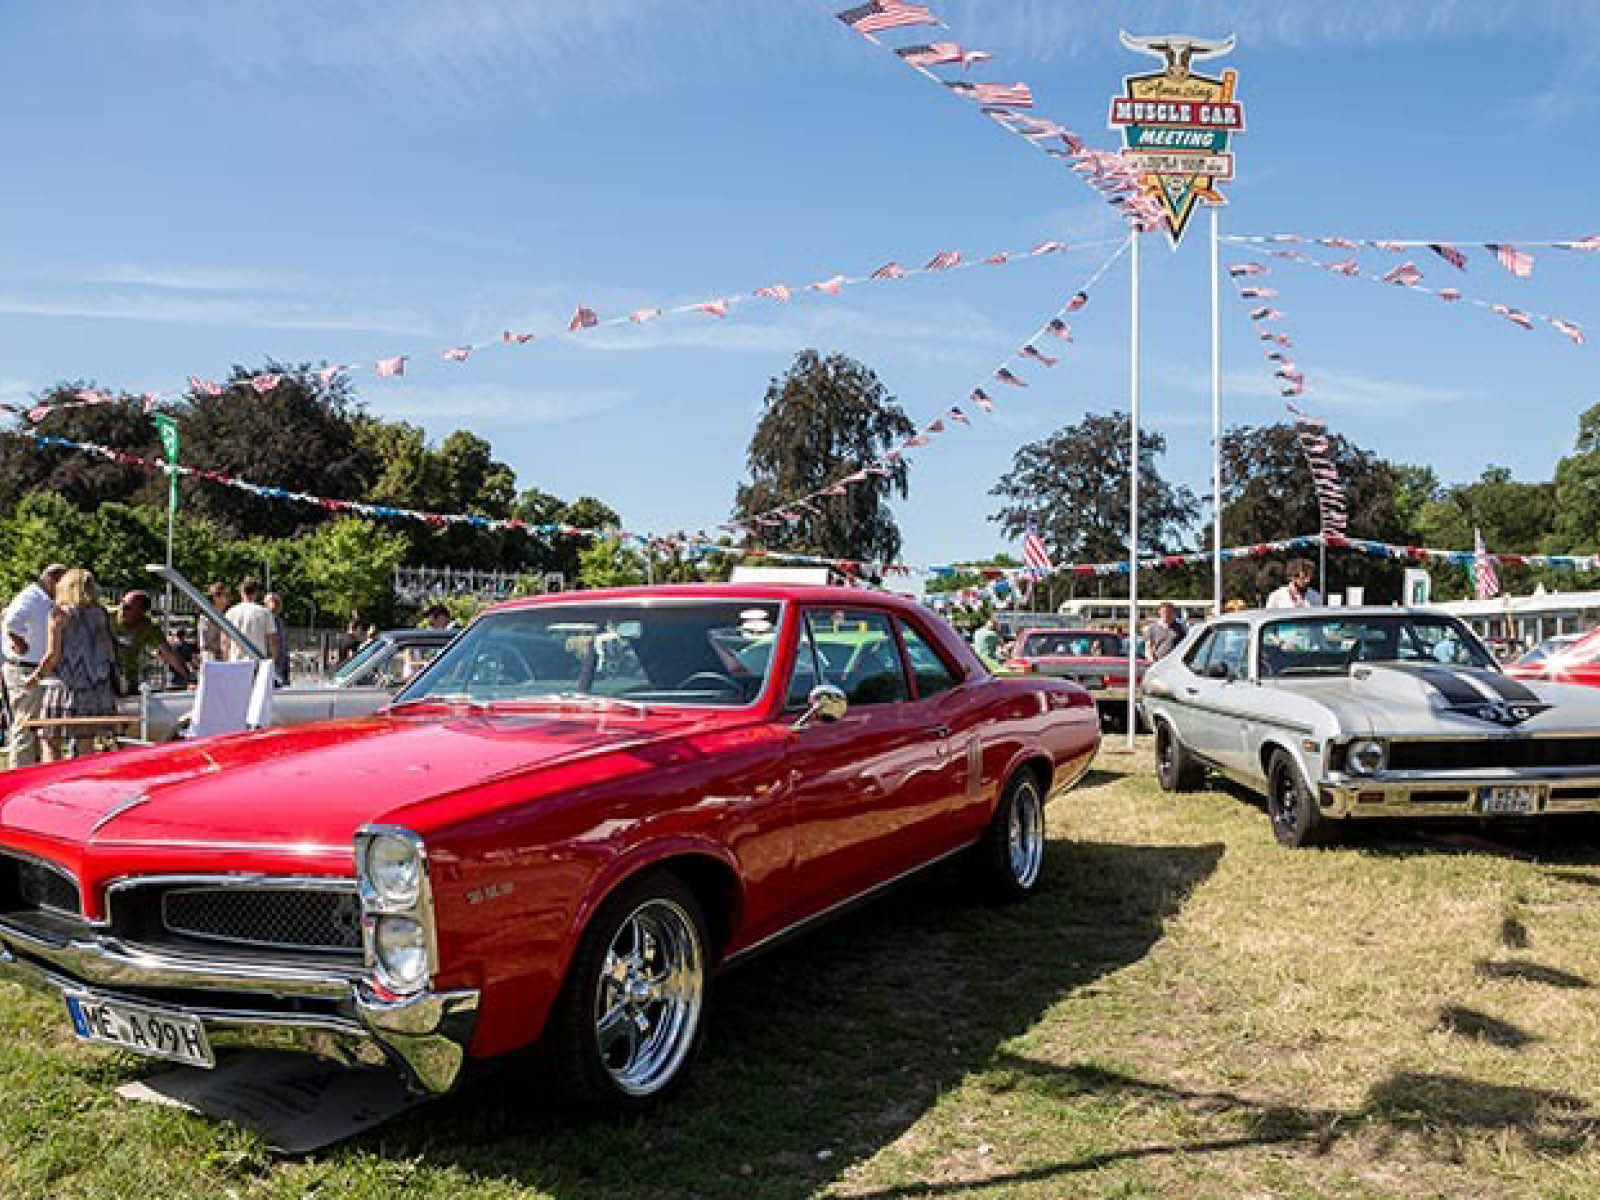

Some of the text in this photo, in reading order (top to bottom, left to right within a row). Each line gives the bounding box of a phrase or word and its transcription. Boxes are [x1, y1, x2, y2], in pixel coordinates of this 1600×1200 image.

[1116, 102, 1236, 124] MUSCLE CAR
[1139, 130, 1216, 145] MEETING
